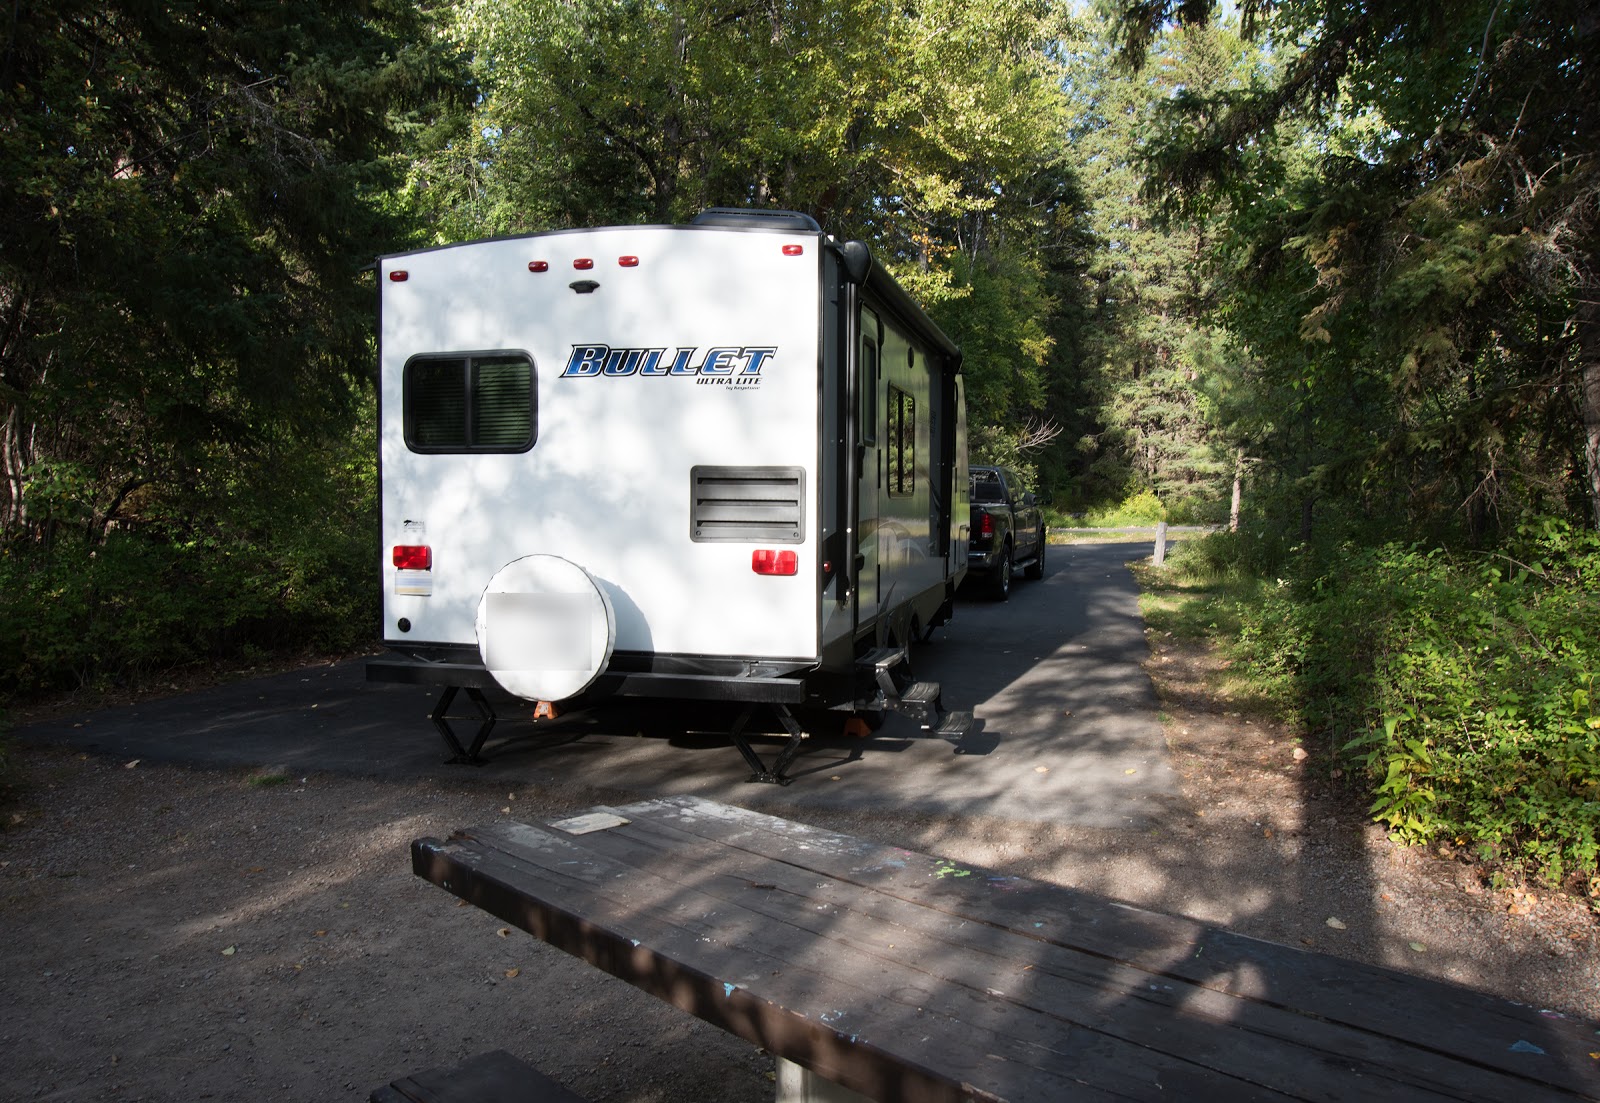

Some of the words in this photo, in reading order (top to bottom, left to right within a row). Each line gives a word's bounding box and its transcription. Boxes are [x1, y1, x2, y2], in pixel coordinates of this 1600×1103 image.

[558, 343, 778, 378] BULLET
[696, 377, 733, 385] ULTRA
[735, 377, 762, 385] LITE
